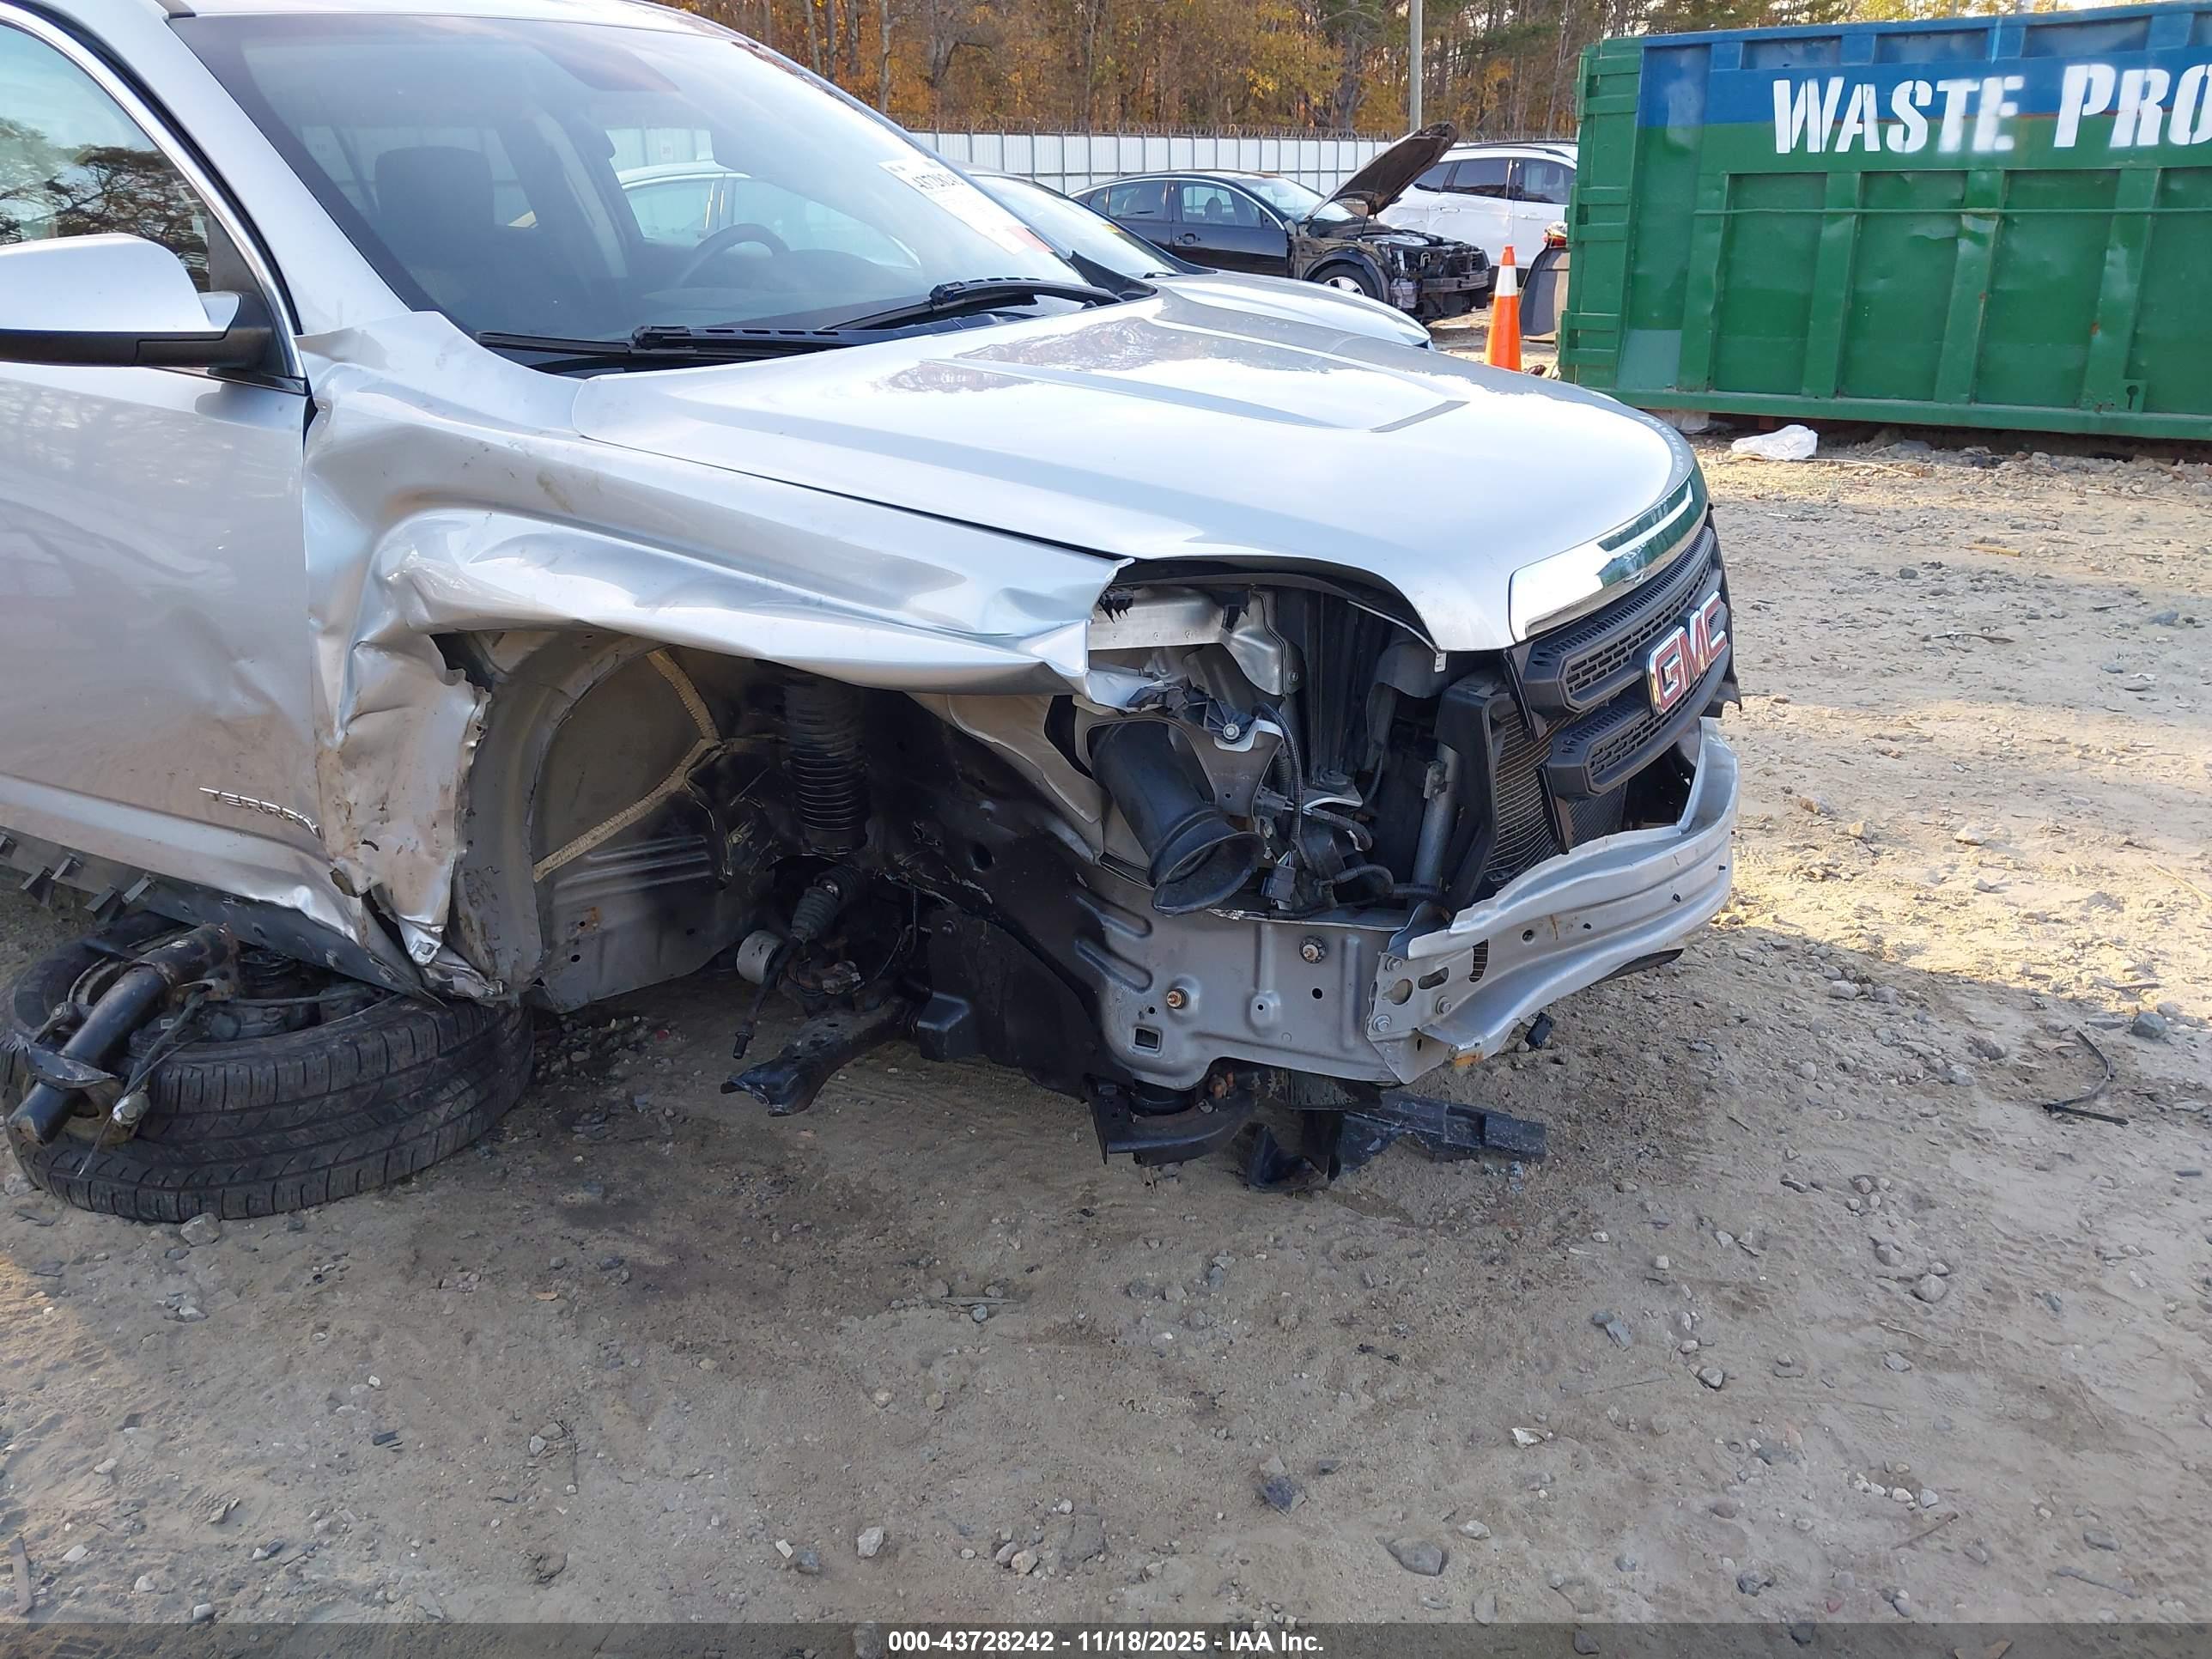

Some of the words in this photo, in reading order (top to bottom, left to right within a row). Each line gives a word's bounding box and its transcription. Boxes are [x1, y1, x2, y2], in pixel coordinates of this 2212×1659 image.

[1772, 76, 2025, 154] WASTE
[2053, 64, 2212, 148] PRO
[1647, 591, 1727, 714] GMC
